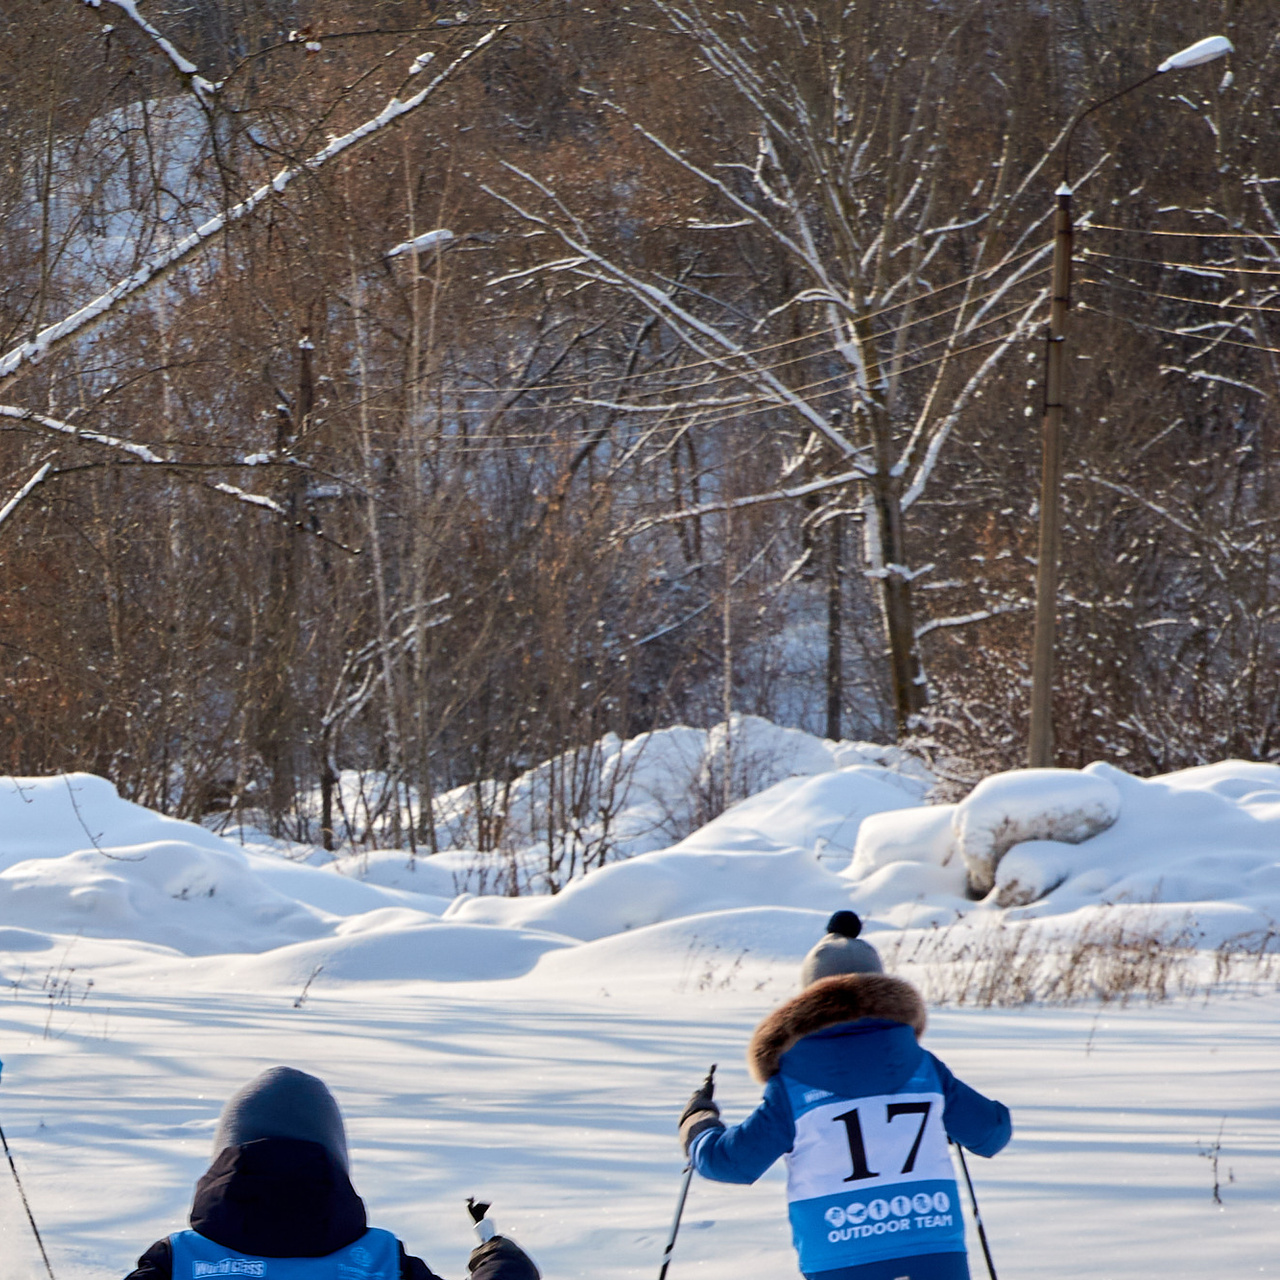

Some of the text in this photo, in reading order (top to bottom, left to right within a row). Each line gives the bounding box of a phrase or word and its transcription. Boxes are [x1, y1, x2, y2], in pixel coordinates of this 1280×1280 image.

[832, 1101, 933, 1183] 17
[827, 1214, 953, 1243] OUTDOOR TEAM
[195, 1261, 231, 1276] World
